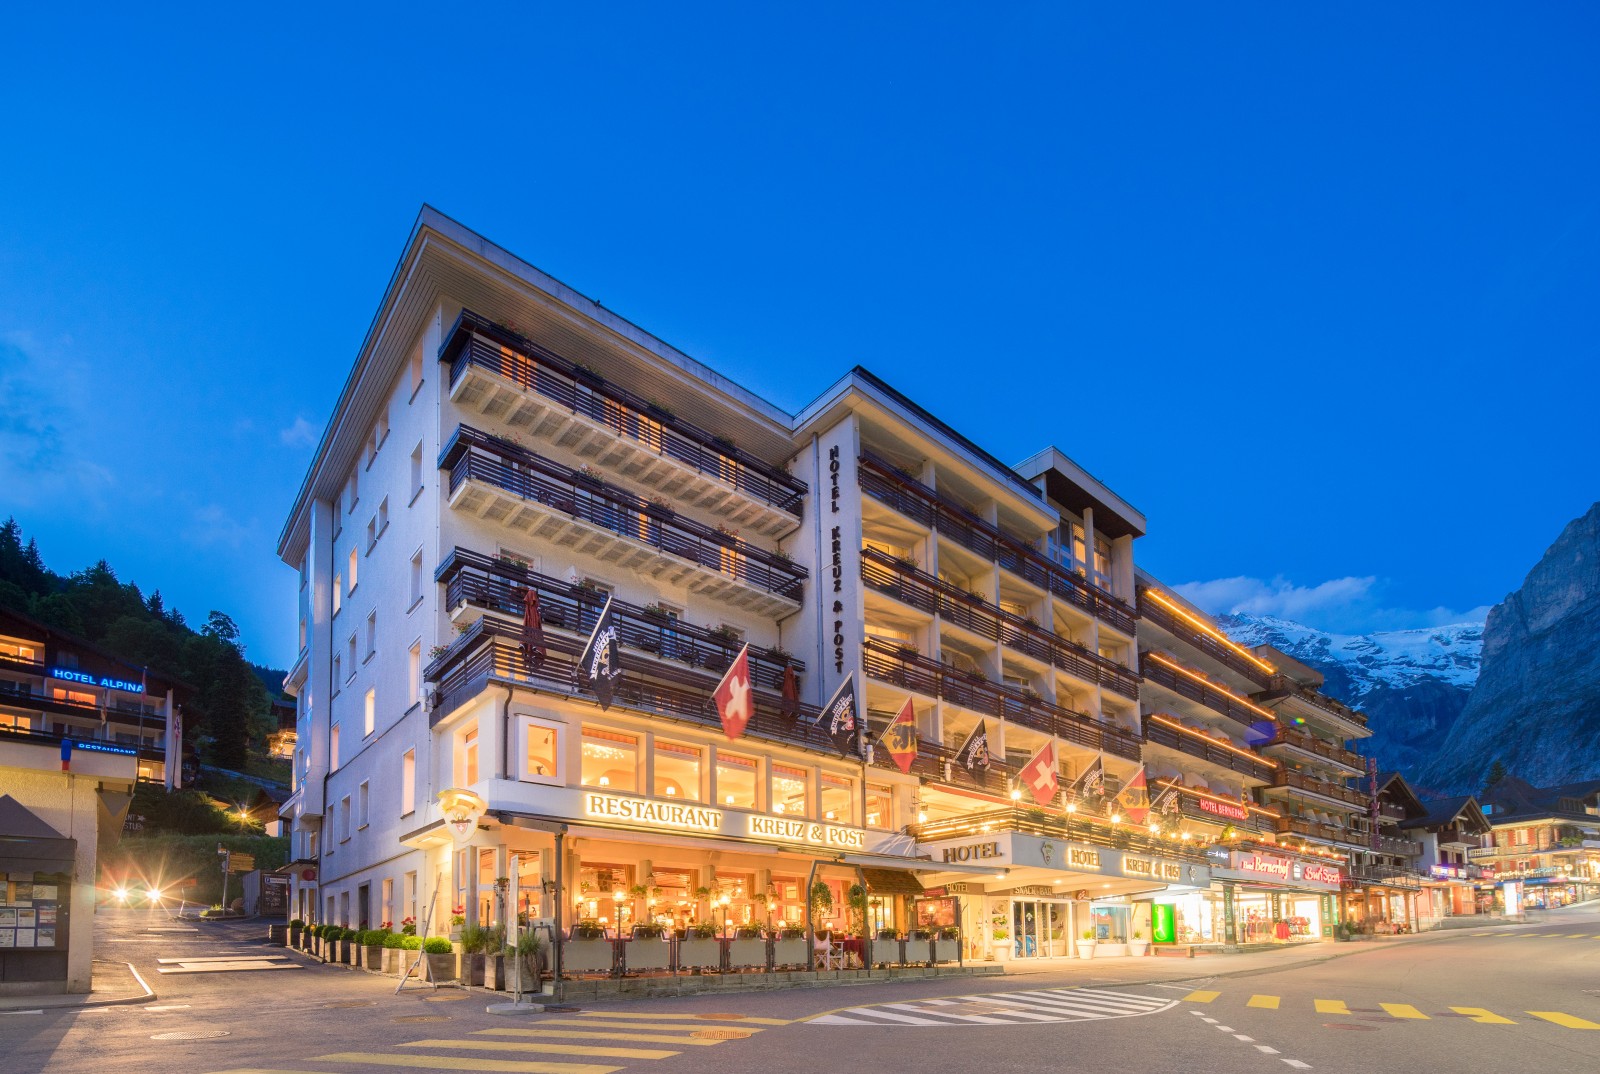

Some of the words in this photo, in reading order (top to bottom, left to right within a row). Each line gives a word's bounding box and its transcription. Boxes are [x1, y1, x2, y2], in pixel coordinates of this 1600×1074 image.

[829, 445, 840, 513] HOTEL
[831, 526, 842, 593] KREUZ
[832, 600, 843, 613] &
[833, 620, 844, 673] POST
[54, 669, 96, 685] HOTEL
[100, 678, 144, 692] ALPINA
[589, 795, 722, 828] RESTAURANT
[1200, 798, 1218, 813] HOTEL
[751, 817, 804, 837] KREUZ
[811, 825, 823, 841] &
[829, 828, 865, 846] POST
[942, 842, 1003, 863] HOTEL
[1071, 849, 1102, 866] HOTEL
[1125, 858, 1151, 873] KREUZ
[1163, 864, 1182, 879] POST
[1254, 856, 1291, 880] Bernerhof
[946, 882, 968, 893] HOTEL
